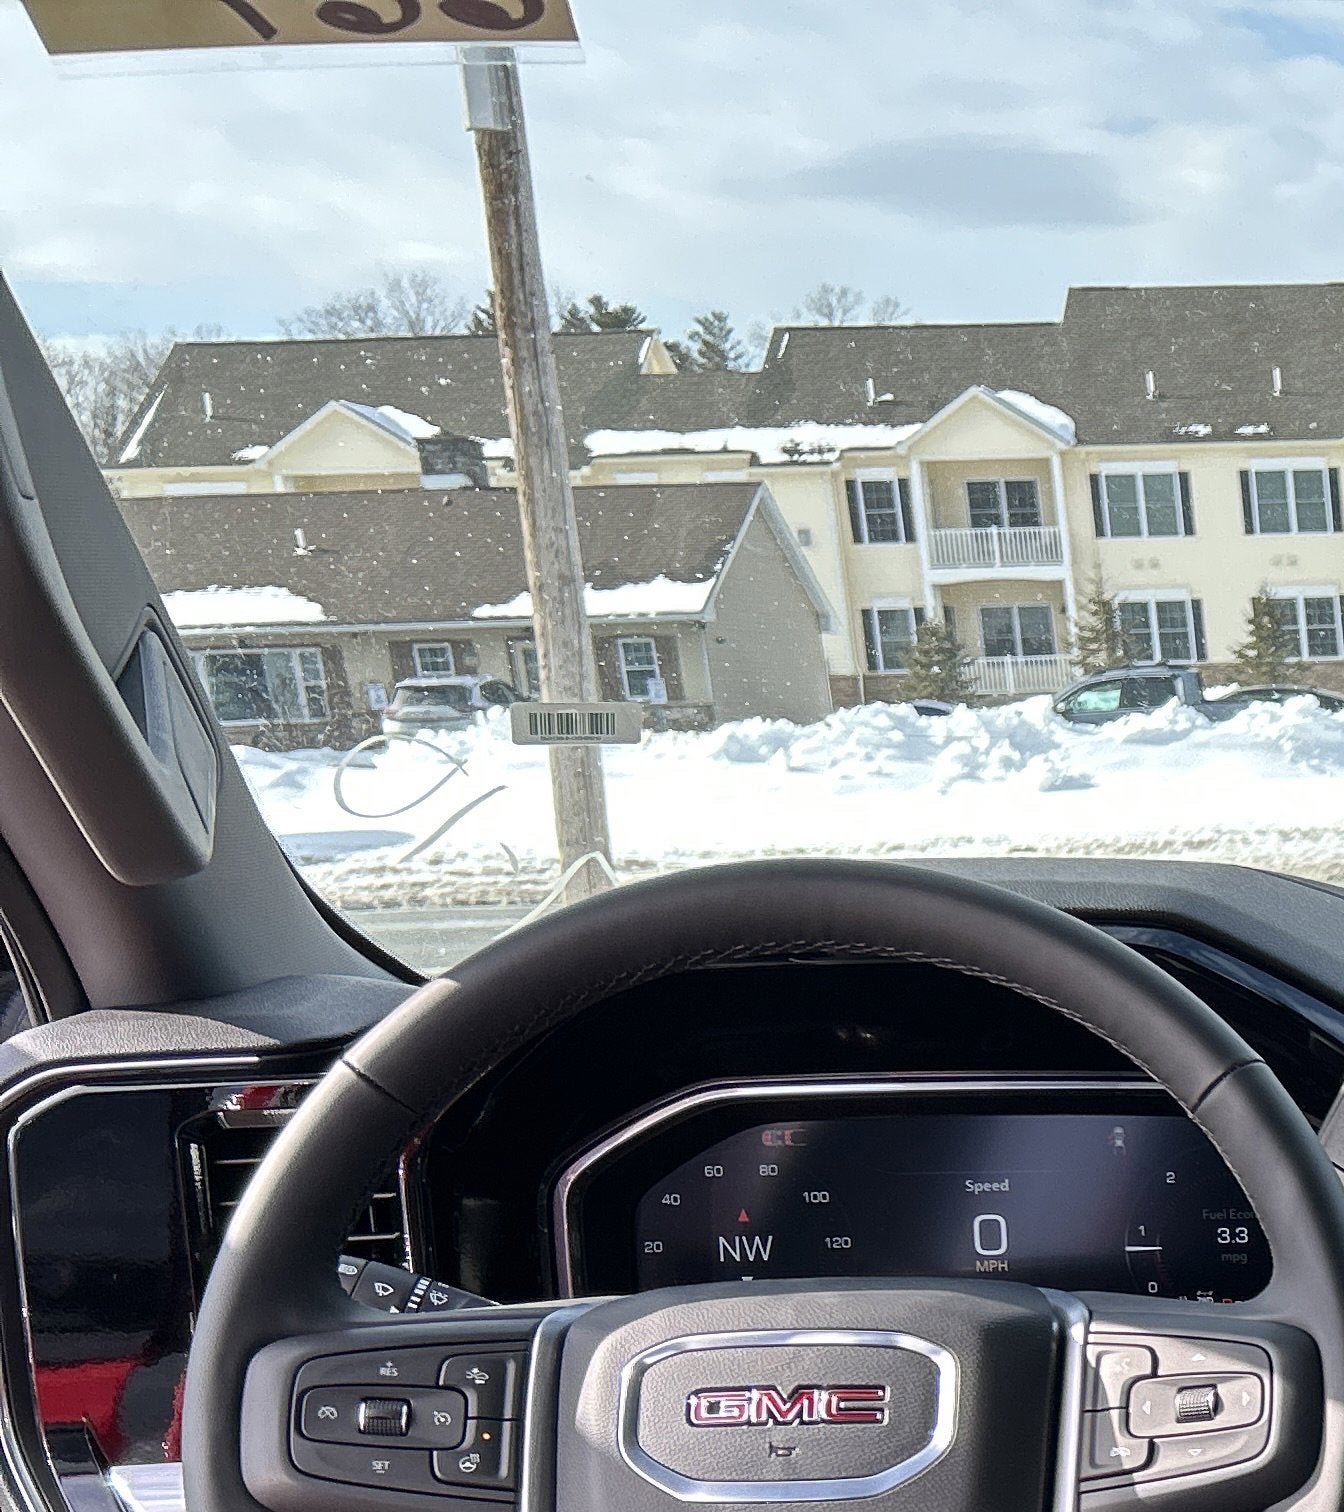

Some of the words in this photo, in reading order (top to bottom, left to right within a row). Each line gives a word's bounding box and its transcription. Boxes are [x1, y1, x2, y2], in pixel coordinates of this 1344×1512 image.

[704, 1165, 723, 1177] 60
[759, 1164, 778, 1176] 80
[1166, 1171, 1176, 1184] 2
[965, 1179, 1010, 1195] Speed
[661, 1194, 680, 1205] 40
[803, 1191, 830, 1203] 100
[1202, 1209, 1227, 1220] Fuel
[972, 1213, 1009, 1257] 0
[1138, 1225, 1146, 1237] 1
[1217, 1226, 1249, 1244] 3.3
[644, 1241, 663, 1253] 20
[825, 1236, 852, 1249] 120
[718, 1235, 773, 1263] NW
[1221, 1254, 1248, 1264] mpg
[975, 1260, 1009, 1273] MPH
[1148, 1281, 1158, 1293] 0
[379, 1367, 399, 1377] RES
[686, 1385, 890, 1428] GMC
[371, 1460, 391, 1471] SET
